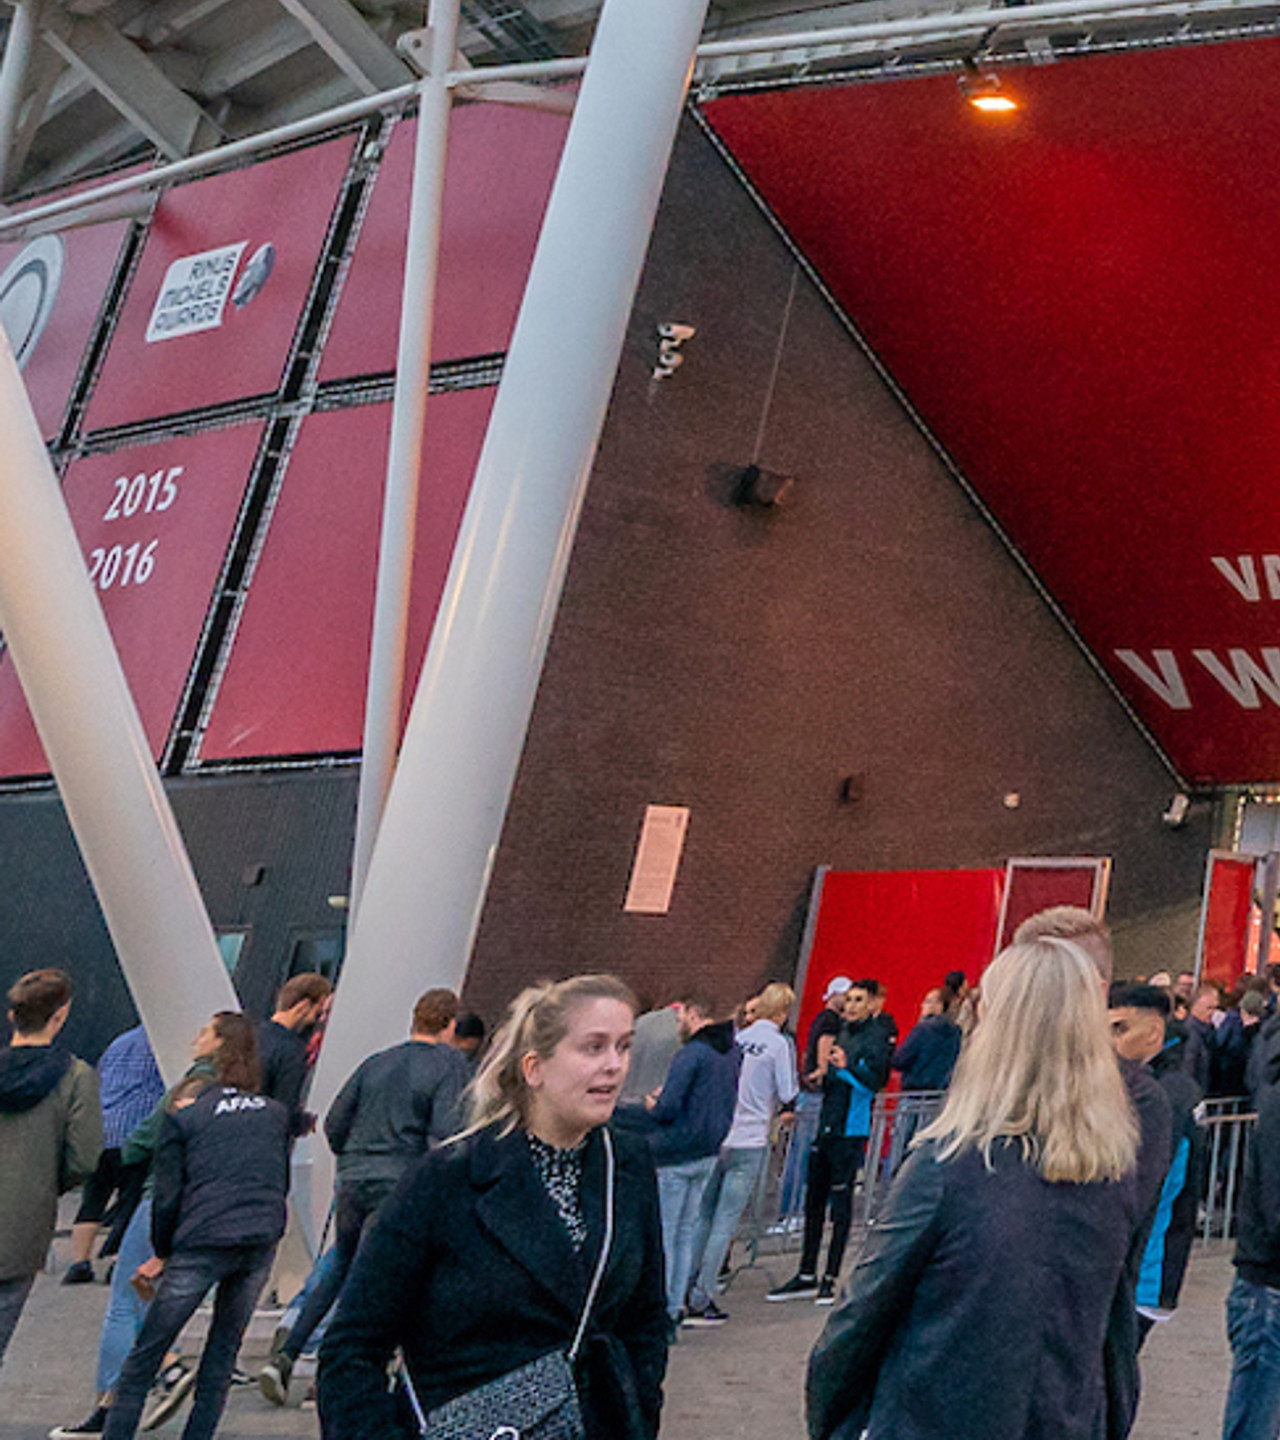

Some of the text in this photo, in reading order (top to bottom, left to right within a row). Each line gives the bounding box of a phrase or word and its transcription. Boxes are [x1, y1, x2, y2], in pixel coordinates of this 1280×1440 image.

[103, 465, 184, 522] 2015
[89, 538, 159, 591] 2016
[214, 1095, 267, 1116] AFAS
